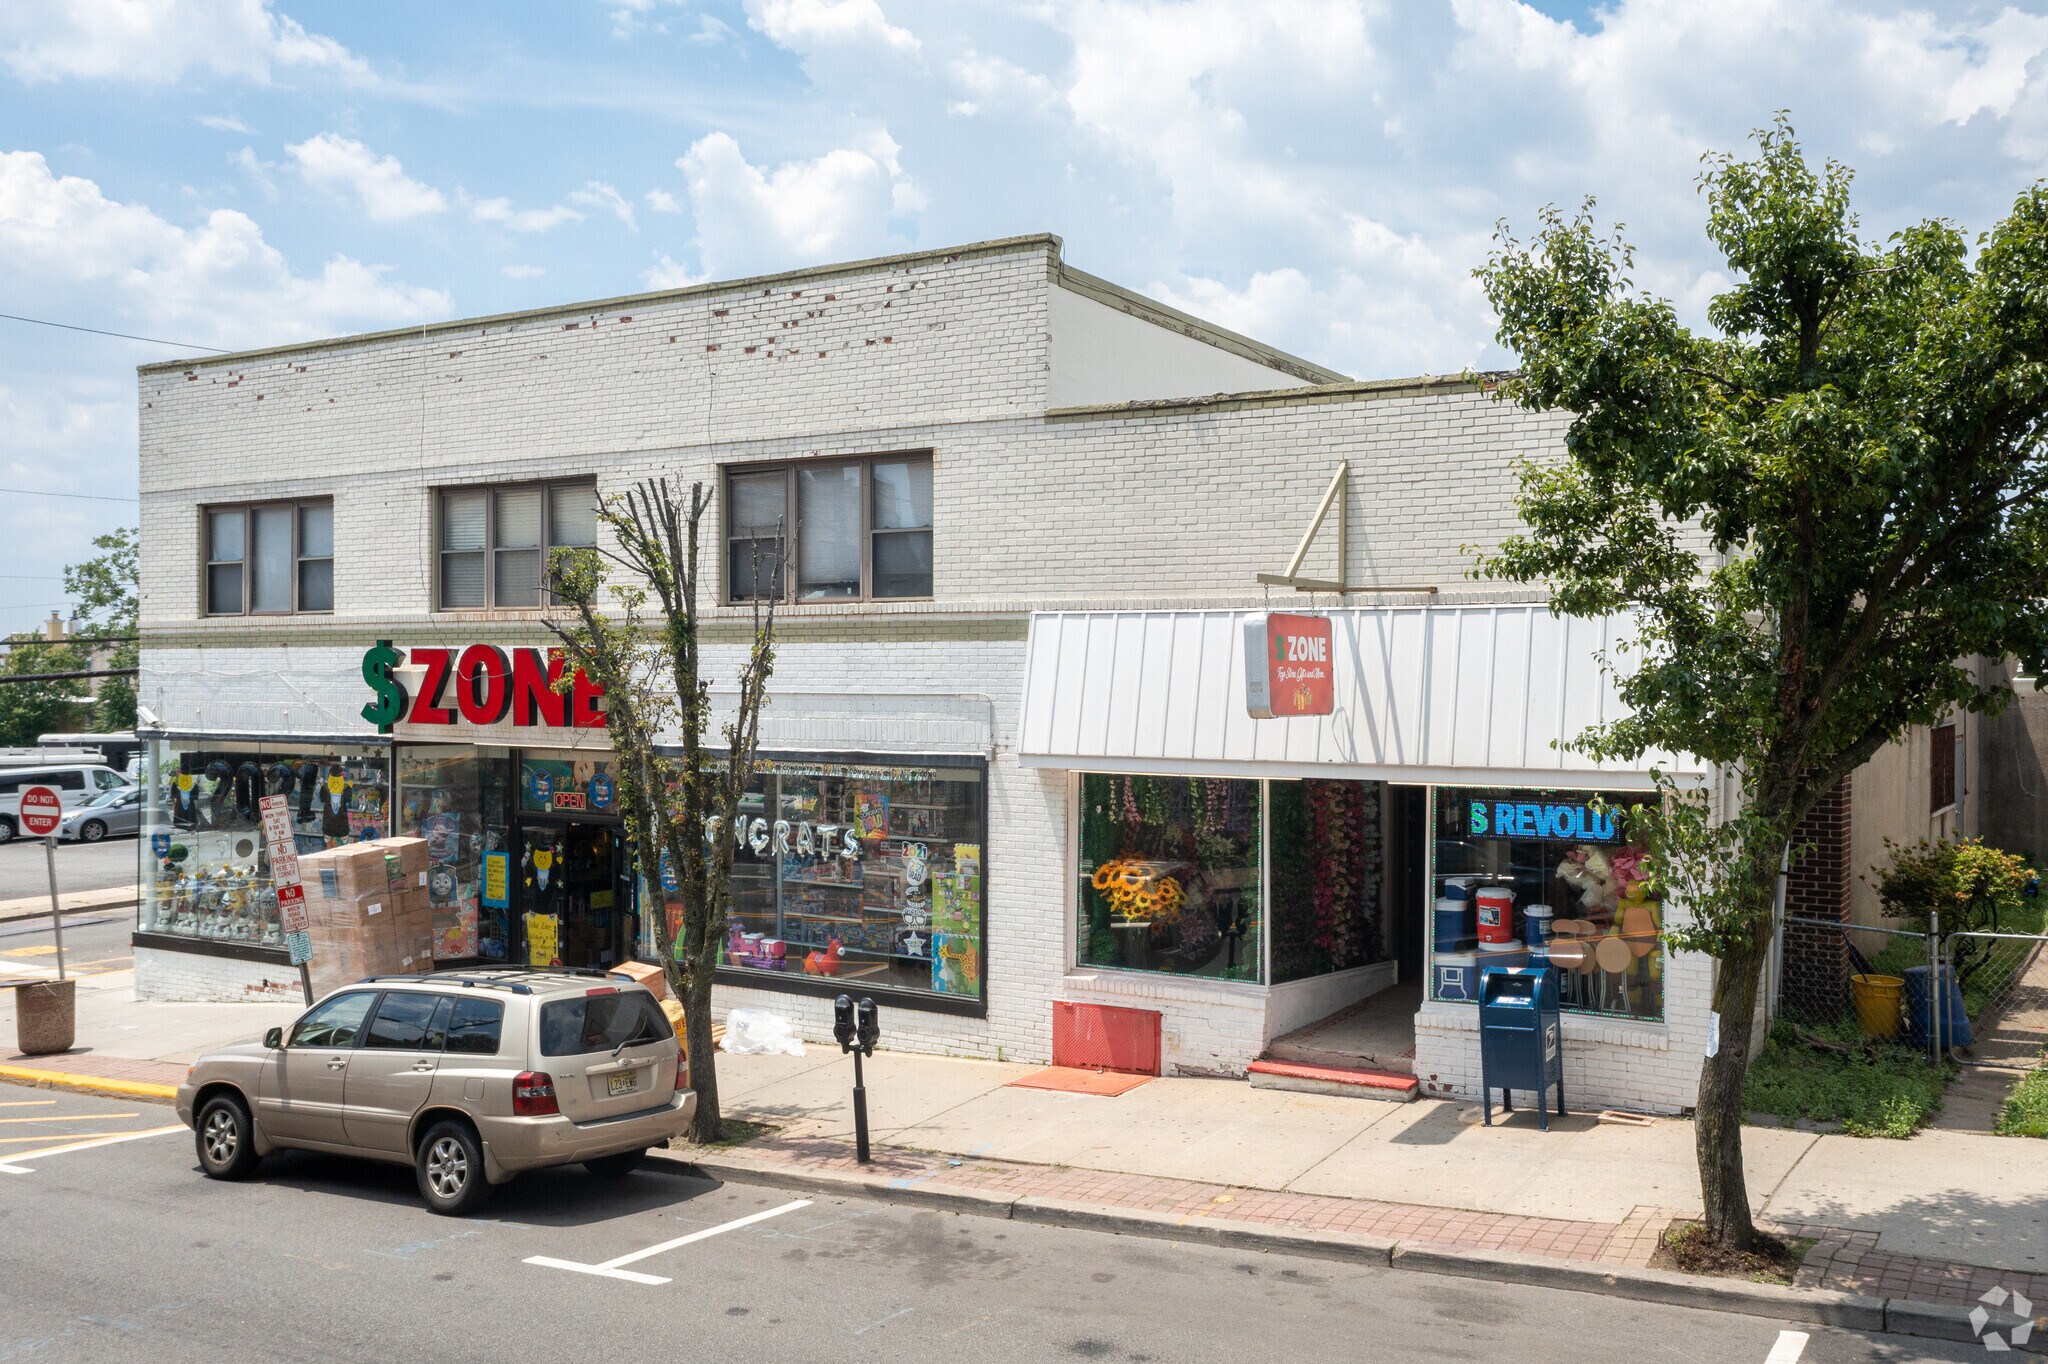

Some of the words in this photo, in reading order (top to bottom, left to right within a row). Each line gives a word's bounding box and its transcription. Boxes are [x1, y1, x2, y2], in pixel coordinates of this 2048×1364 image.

[27, 795, 38, 803] DO
[40, 796, 54, 804] NOT
[260, 799, 271, 809] NO
[555, 793, 585, 808] OPEN
[29, 817, 52, 826] ENTER
[277, 846, 287, 854] NO
[902, 845, 927, 859] 2021
[272, 854, 296, 865] PARKING
[278, 870, 295, 878] CORNER
[285, 888, 295, 898] NO
[280, 896, 304, 907] PARKING
[285, 921, 308, 930] COVERED
